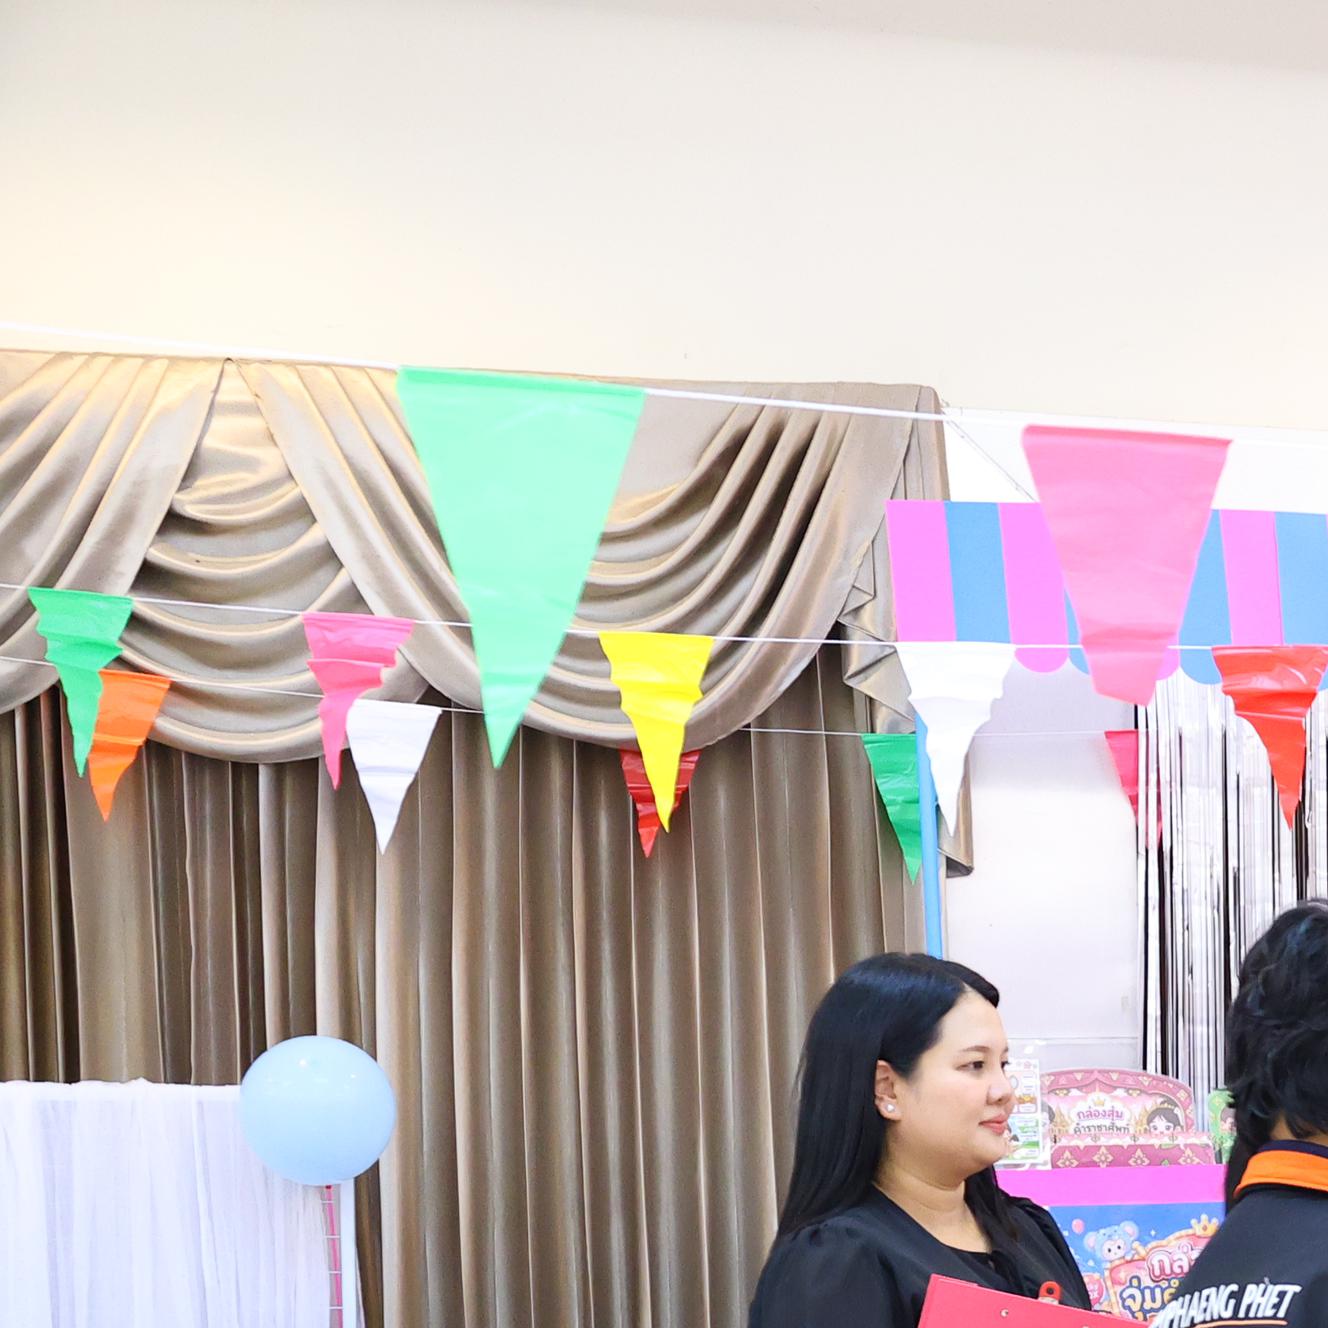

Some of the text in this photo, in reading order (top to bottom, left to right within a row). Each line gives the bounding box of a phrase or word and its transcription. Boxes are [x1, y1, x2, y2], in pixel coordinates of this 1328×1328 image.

[1077, 1107, 1123, 1124] กล่องสุ่ม
[1238, 1283, 1303, 1318] PHET
